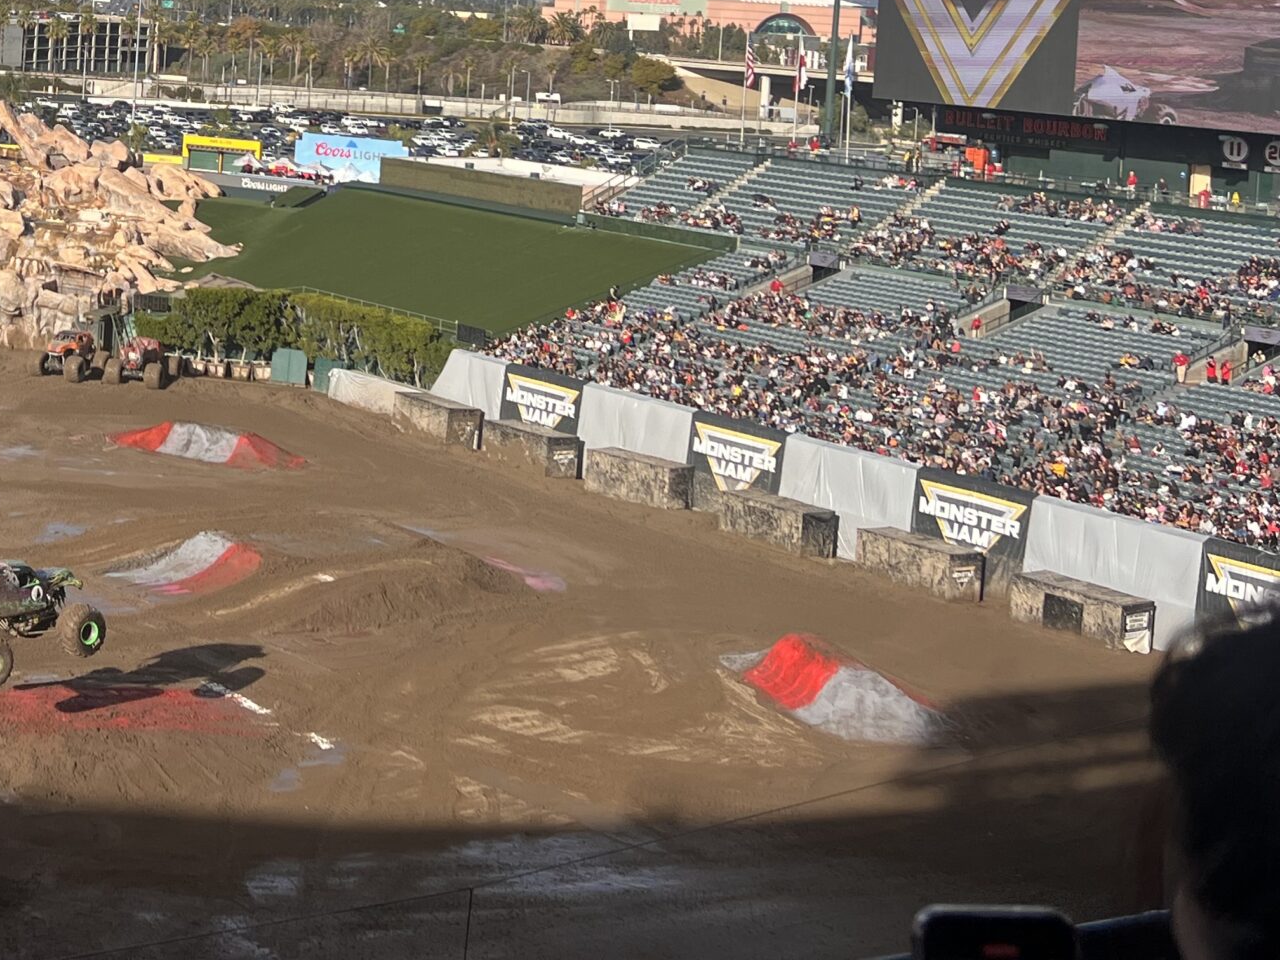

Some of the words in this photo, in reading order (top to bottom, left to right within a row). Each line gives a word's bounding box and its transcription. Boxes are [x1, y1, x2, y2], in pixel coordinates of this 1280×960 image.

[1023, 117, 1108, 141] BOURBON
[315, 142, 351, 159] Coors
[1229, 141, 1242, 157] 11
[1268, 145, 1280, 161] 2
[241, 177, 266, 189] Coors
[266, 183, 288, 192] LIGHT
[506, 387, 575, 419] MONSTER
[525, 407, 556, 429] JAM
[692, 436, 777, 473] MONSTER
[716, 459, 752, 484] JAM
[918, 496, 1021, 539] MONSTER
[947, 522, 989, 548] JAM
